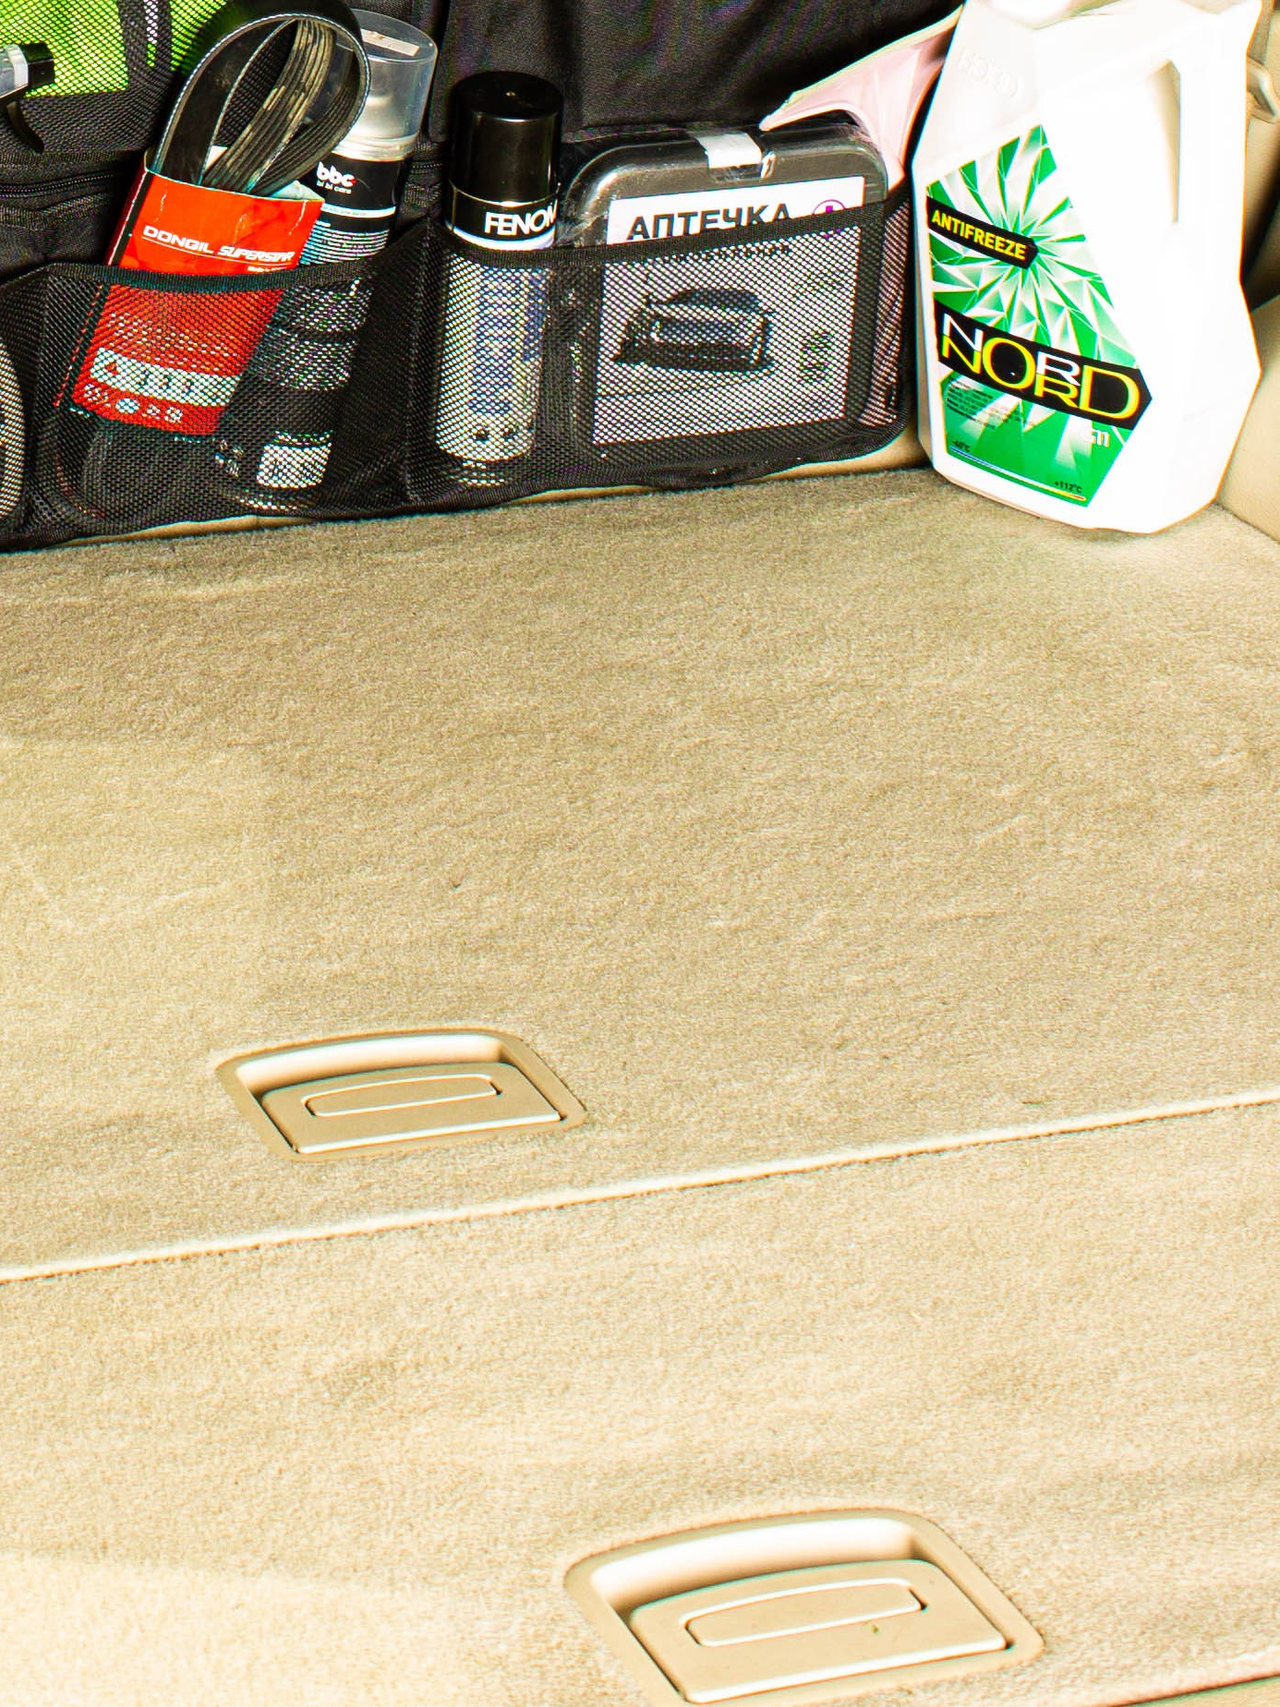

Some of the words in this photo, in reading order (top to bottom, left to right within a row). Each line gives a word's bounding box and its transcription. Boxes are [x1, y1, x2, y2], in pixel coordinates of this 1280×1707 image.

[316, 161, 357, 187] bbc
[626, 203, 792, 241] АПТЕЧКА
[931, 209, 1027, 261] ANTIFREEZE
[143, 225, 214, 254] DONGIL
[217, 245, 295, 262] SUPERSTAR
[942, 312, 1140, 420] NORD
